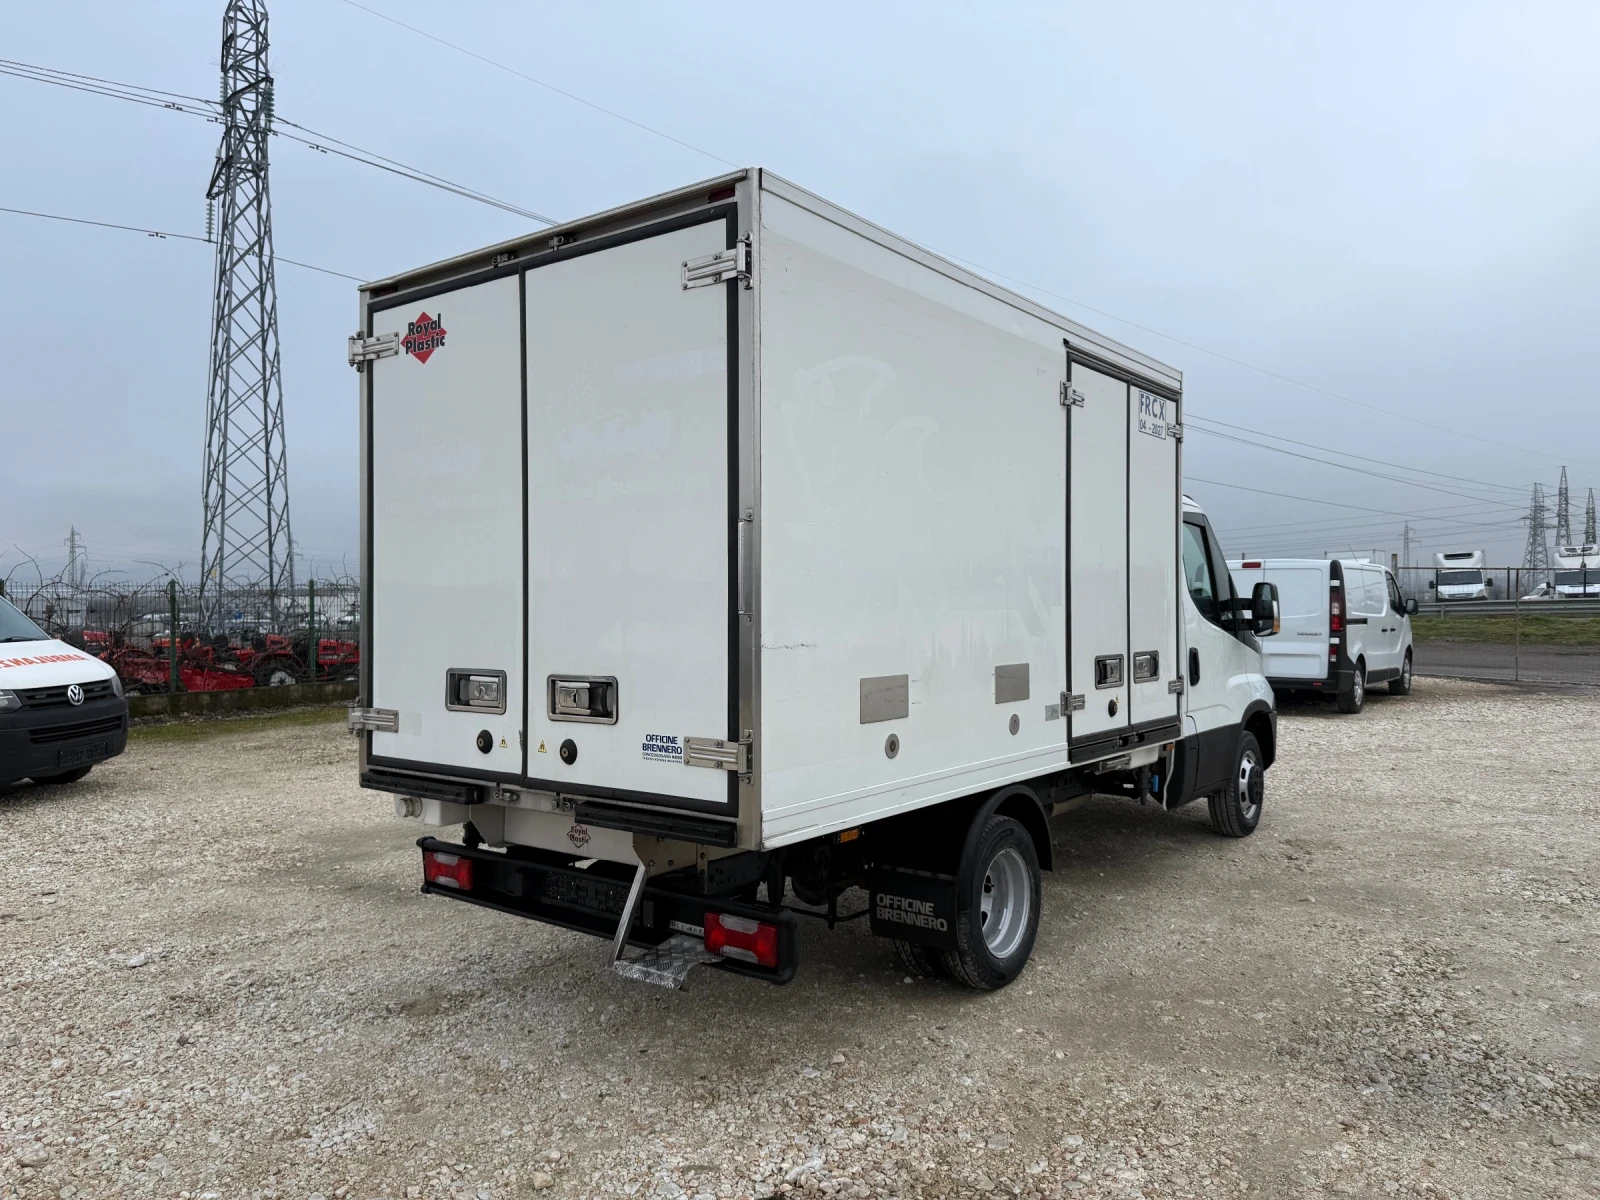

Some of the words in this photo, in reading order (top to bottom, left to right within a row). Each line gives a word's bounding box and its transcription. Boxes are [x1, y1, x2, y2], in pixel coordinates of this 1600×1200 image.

[408, 313, 441, 338] Royal
[406, 331, 445, 355] Plastic
[1141, 393, 1164, 421] FRCX
[642, 743, 683, 755] BRENNERO
[645, 734, 678, 745] OFFICINE
[876, 893, 935, 916] OFFICINE
[876, 906, 948, 932] BRENNERO
